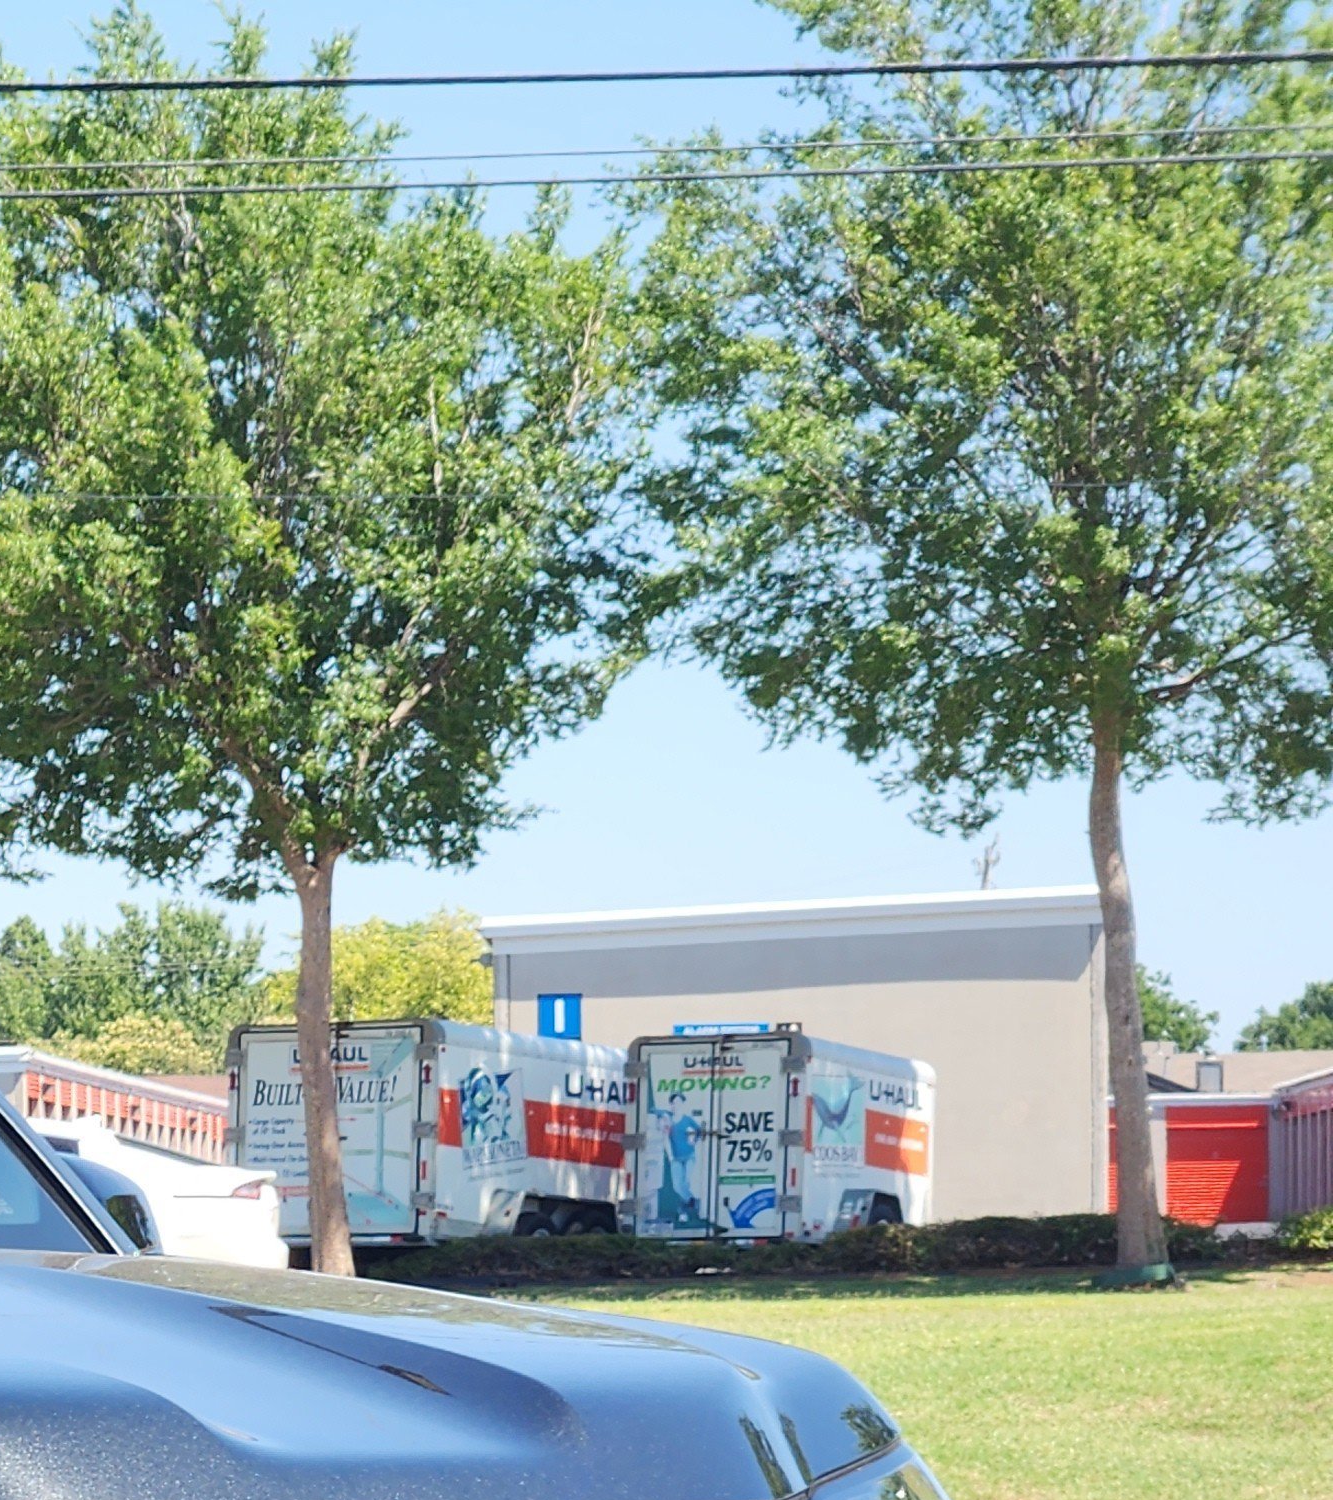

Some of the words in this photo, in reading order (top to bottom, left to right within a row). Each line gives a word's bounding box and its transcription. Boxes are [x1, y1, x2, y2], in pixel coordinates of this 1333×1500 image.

[657, 1075, 772, 1093] MOVING?
[724, 1111, 775, 1134] SAVE
[726, 1138, 773, 1163] 75%
